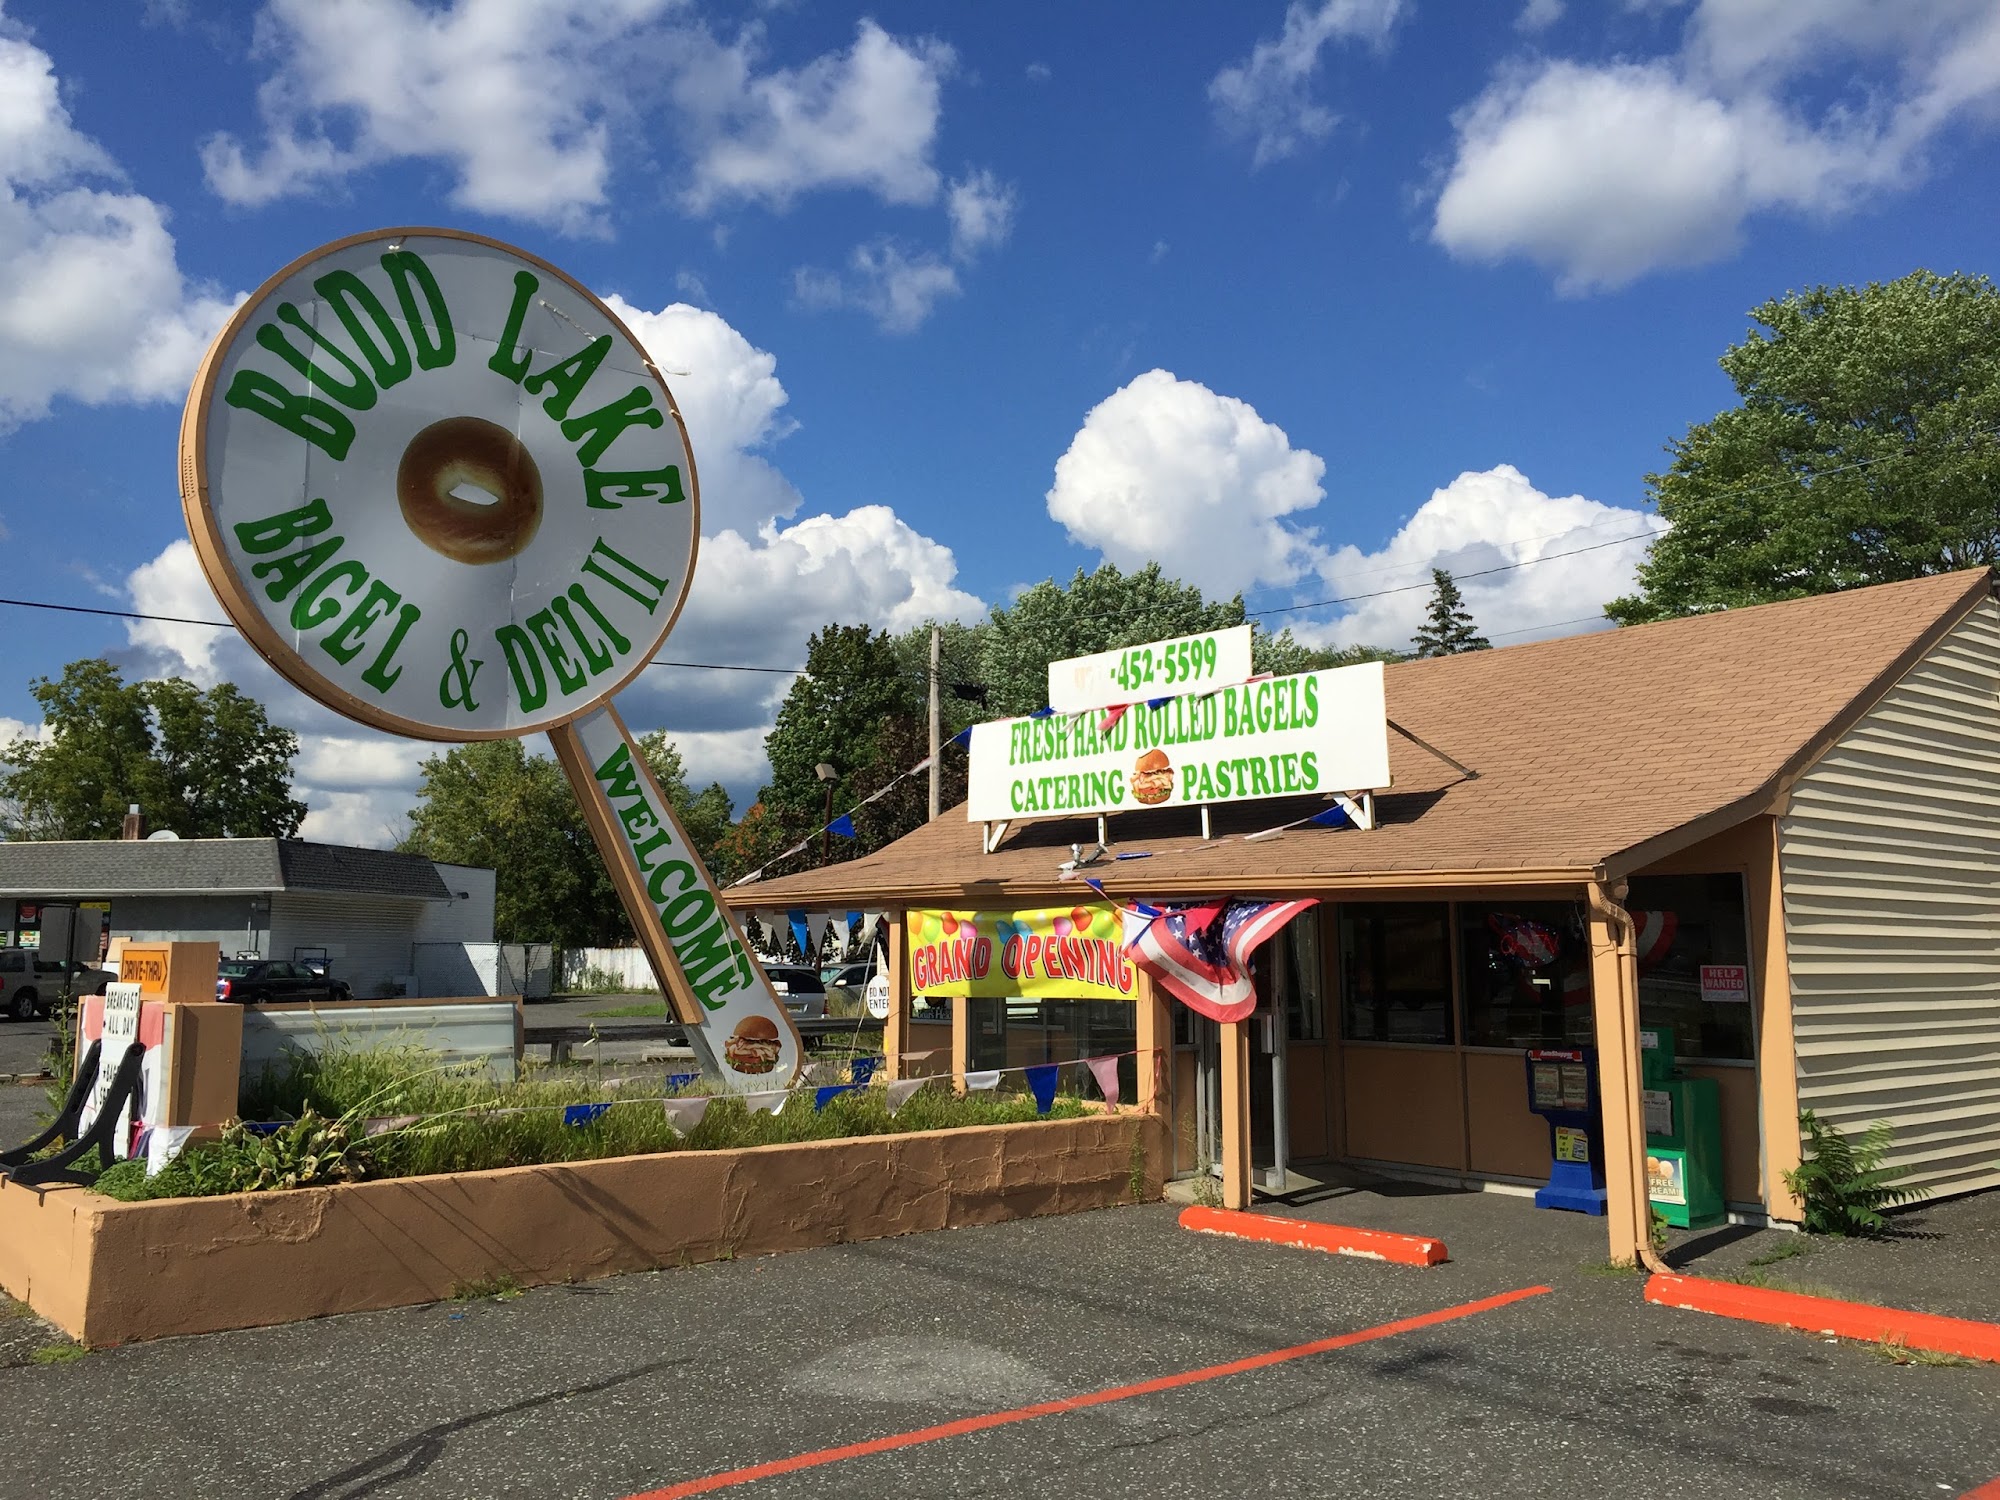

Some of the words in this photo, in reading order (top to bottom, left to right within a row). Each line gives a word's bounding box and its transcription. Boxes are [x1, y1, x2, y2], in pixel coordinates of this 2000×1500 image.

[225, 250, 456, 461] BUDD
[488, 270, 686, 510] LAKE
[233, 498, 422, 694] BAGEL
[438, 628, 485, 712] &
[495, 582, 632, 714] DELI
[581, 536, 670, 616] II
[1110, 637, 1218, 692] -452-5599
[1009, 704, 1069, 766] FRESH
[1073, 700, 1129, 759] HAND
[1134, 690, 1218, 751] ROLLED
[1223, 674, 1319, 739] BAGELS
[1010, 769, 1126, 814] CATERING
[1181, 751, 1320, 801] PASTRIES
[595, 741, 754, 1012] WELCOME
[123, 960, 164, 982] DRIVE-THRU
[912, 935, 993, 992] GRAND
[1001, 933, 1134, 995] OPENING
[1704, 978, 1745, 990] WANTED
[1709, 968, 1738, 979] HELP
[106, 991, 138, 1011] BREAKFAST
[108, 1015, 119, 1035] ALL
[122, 1016, 134, 1036] DAY
[1651, 1178, 1674, 1187] FREE
